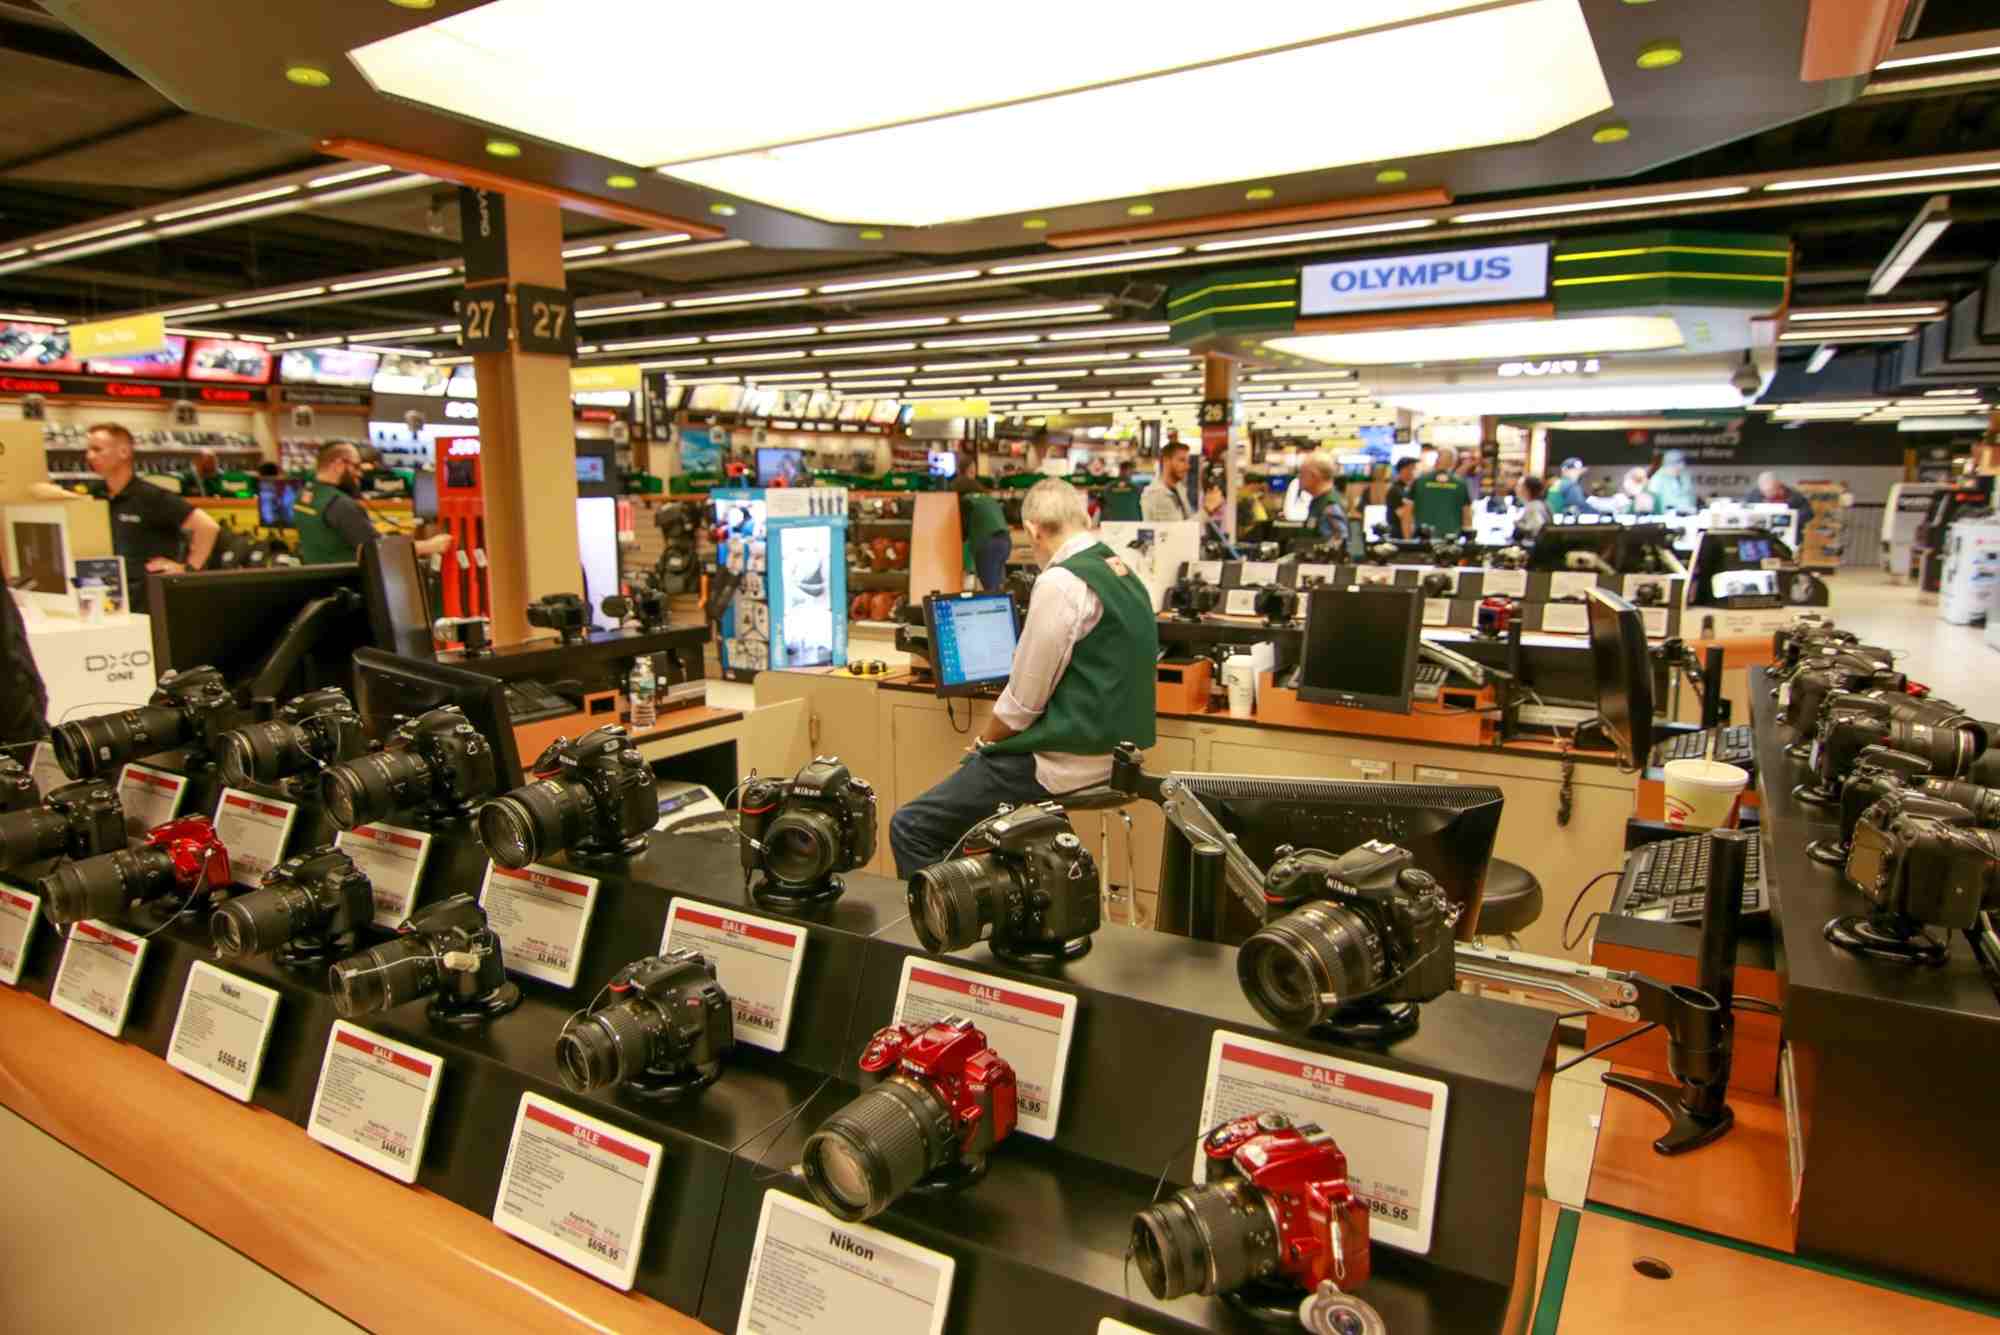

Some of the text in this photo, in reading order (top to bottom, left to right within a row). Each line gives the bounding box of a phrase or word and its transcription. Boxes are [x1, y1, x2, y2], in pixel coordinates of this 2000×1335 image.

[1330, 256, 1512, 292] OLYMPUS
[467, 302, 495, 339] 27
[533, 302, 566, 340] 27
[1204, 403, 1223, 422] 26
[106, 671, 135, 682] ONE
[793, 785, 821, 797] Nikon
[1326, 877, 1359, 896] Nikon
[720, 918, 749, 935] SALE
[968, 982, 1001, 1001] SALE
[371, 1045, 393, 1062] SALE
[1302, 1065, 1345, 1087] SALE
[573, 1125, 600, 1145] SALE
[829, 1231, 874, 1261] Nikon
